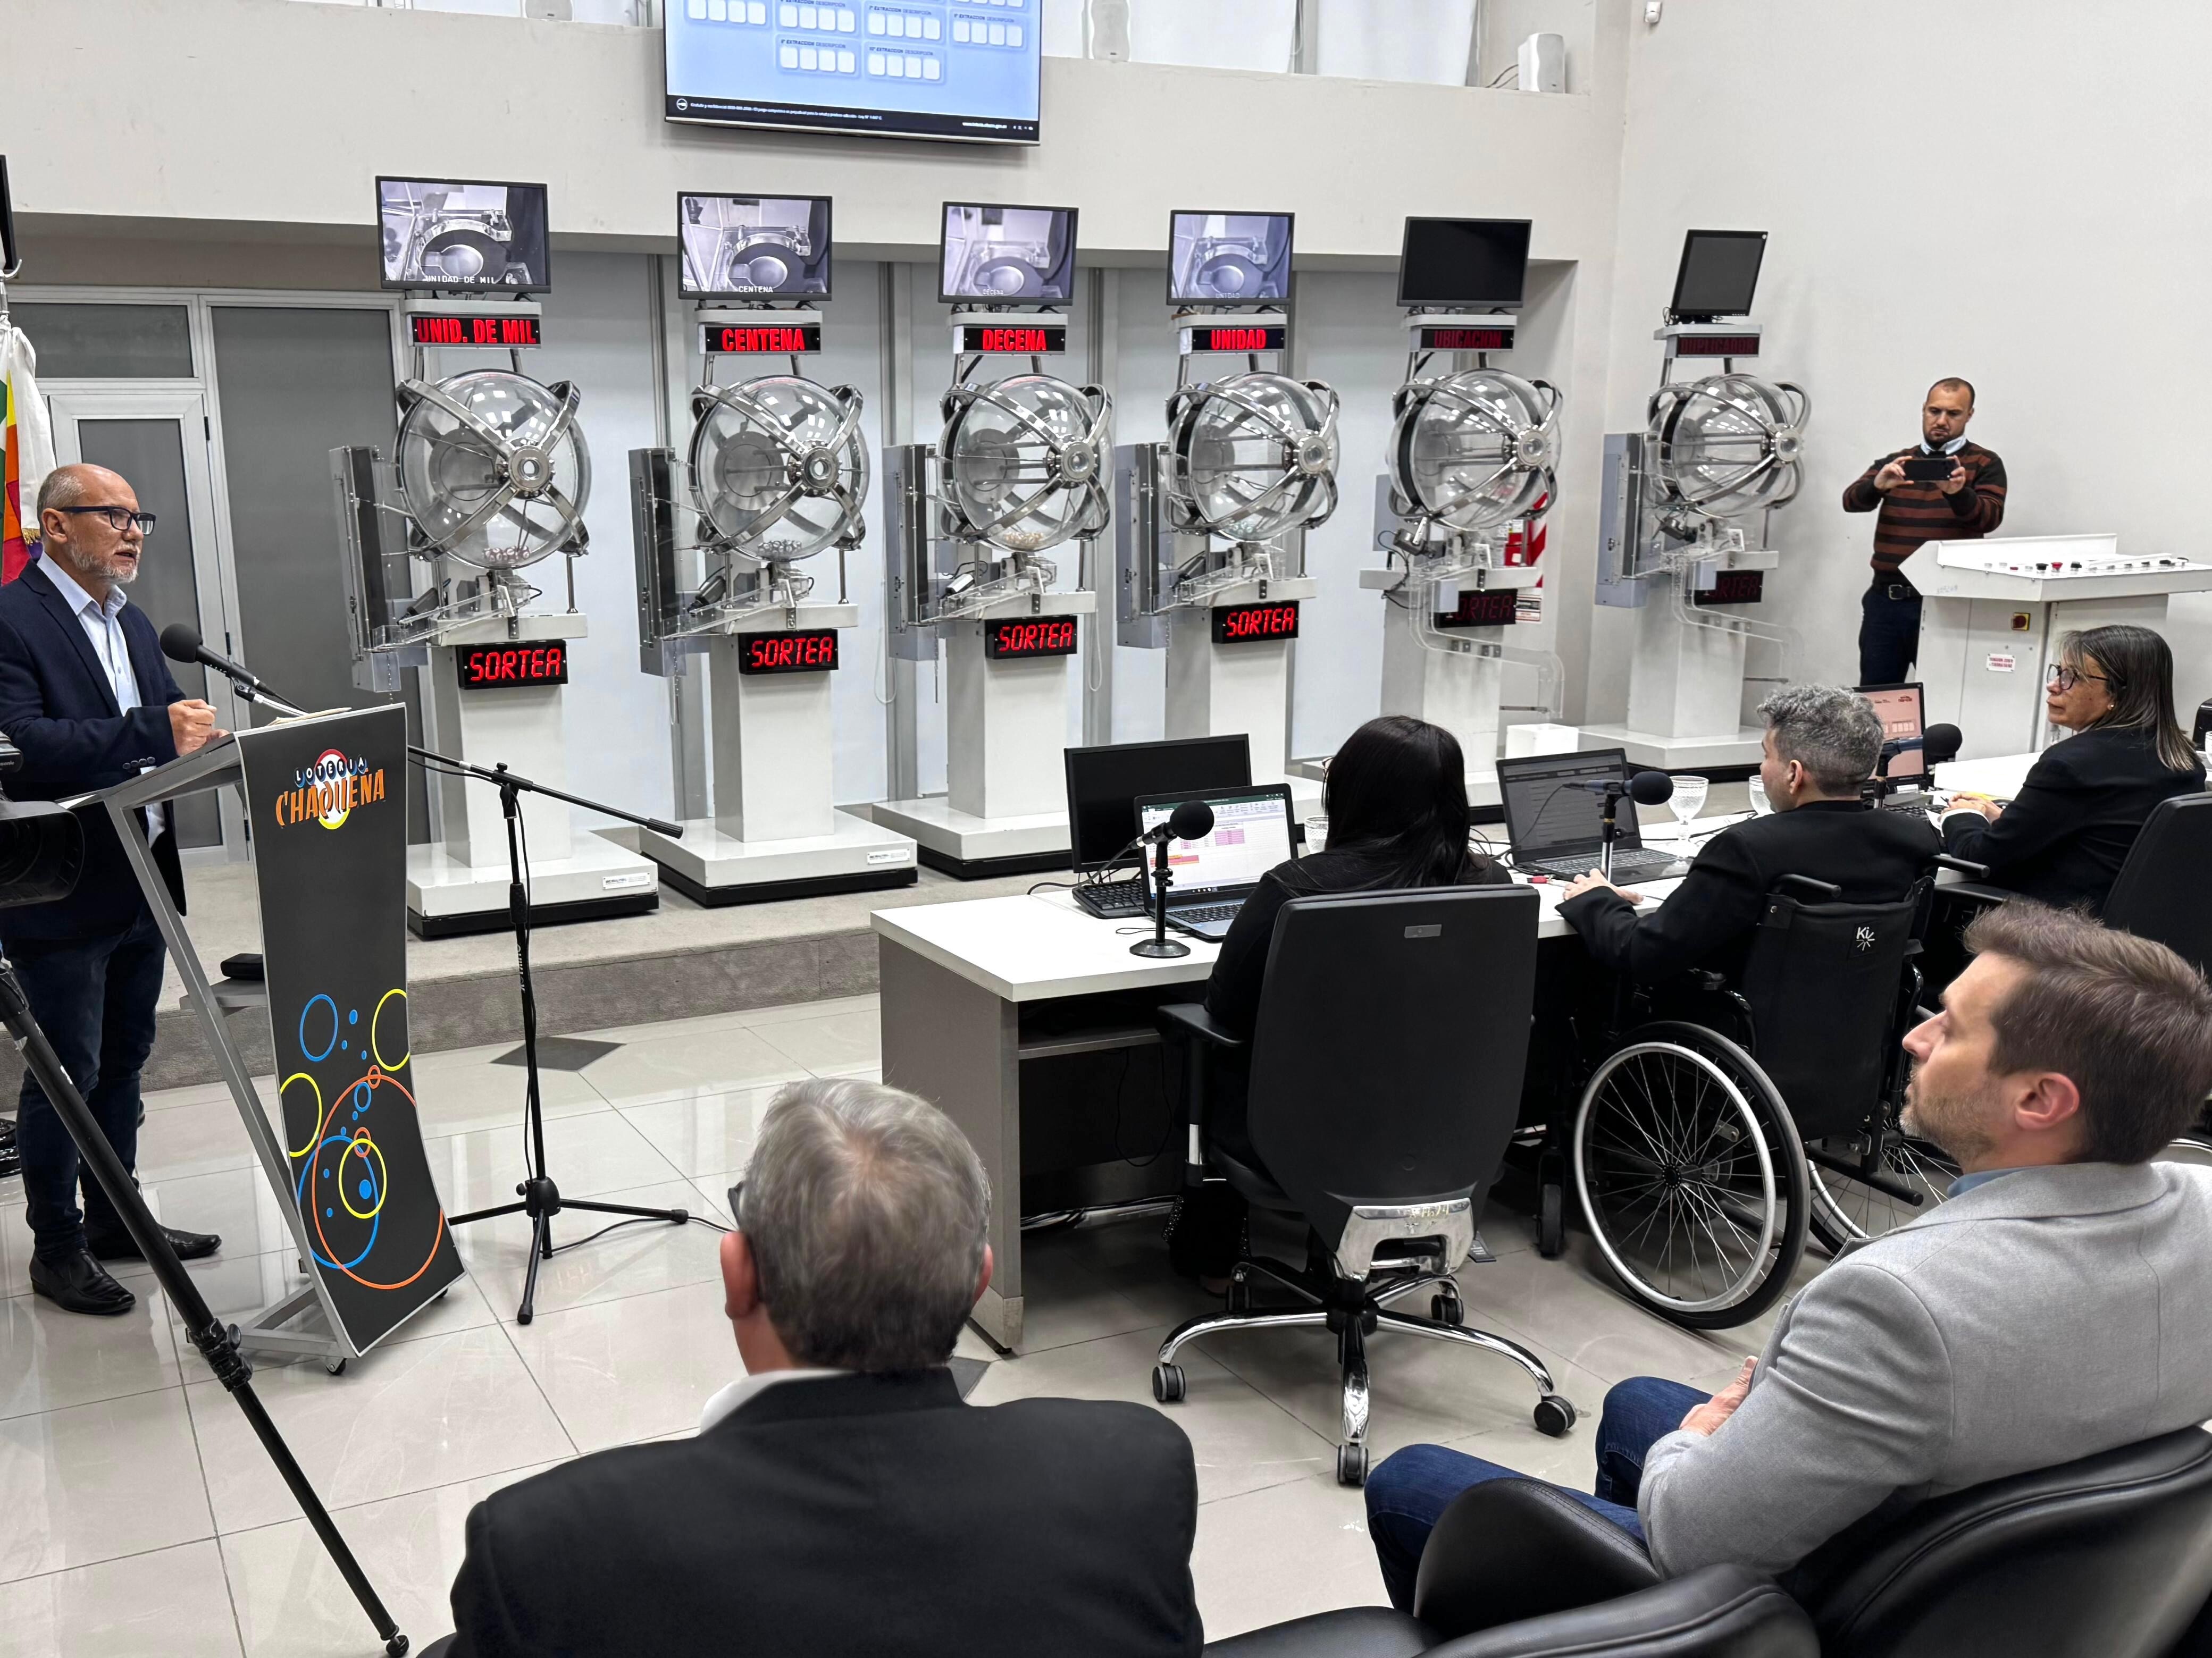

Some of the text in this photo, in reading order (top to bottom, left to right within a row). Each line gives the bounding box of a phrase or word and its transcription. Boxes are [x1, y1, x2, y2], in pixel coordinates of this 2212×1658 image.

[416, 318, 537, 343] UNID. DE MIL
[722, 328, 806, 351] CENTENA
[982, 329, 1047, 351] DECENA
[1211, 329, 1267, 350] UNIDAD
[1227, 607, 1295, 637] SORTEA
[999, 621, 1074, 652] SORTEA
[470, 647, 562, 682] SORTEA
[751, 636, 833, 668] SORTEA
[295, 756, 365, 782] LOTERIA
